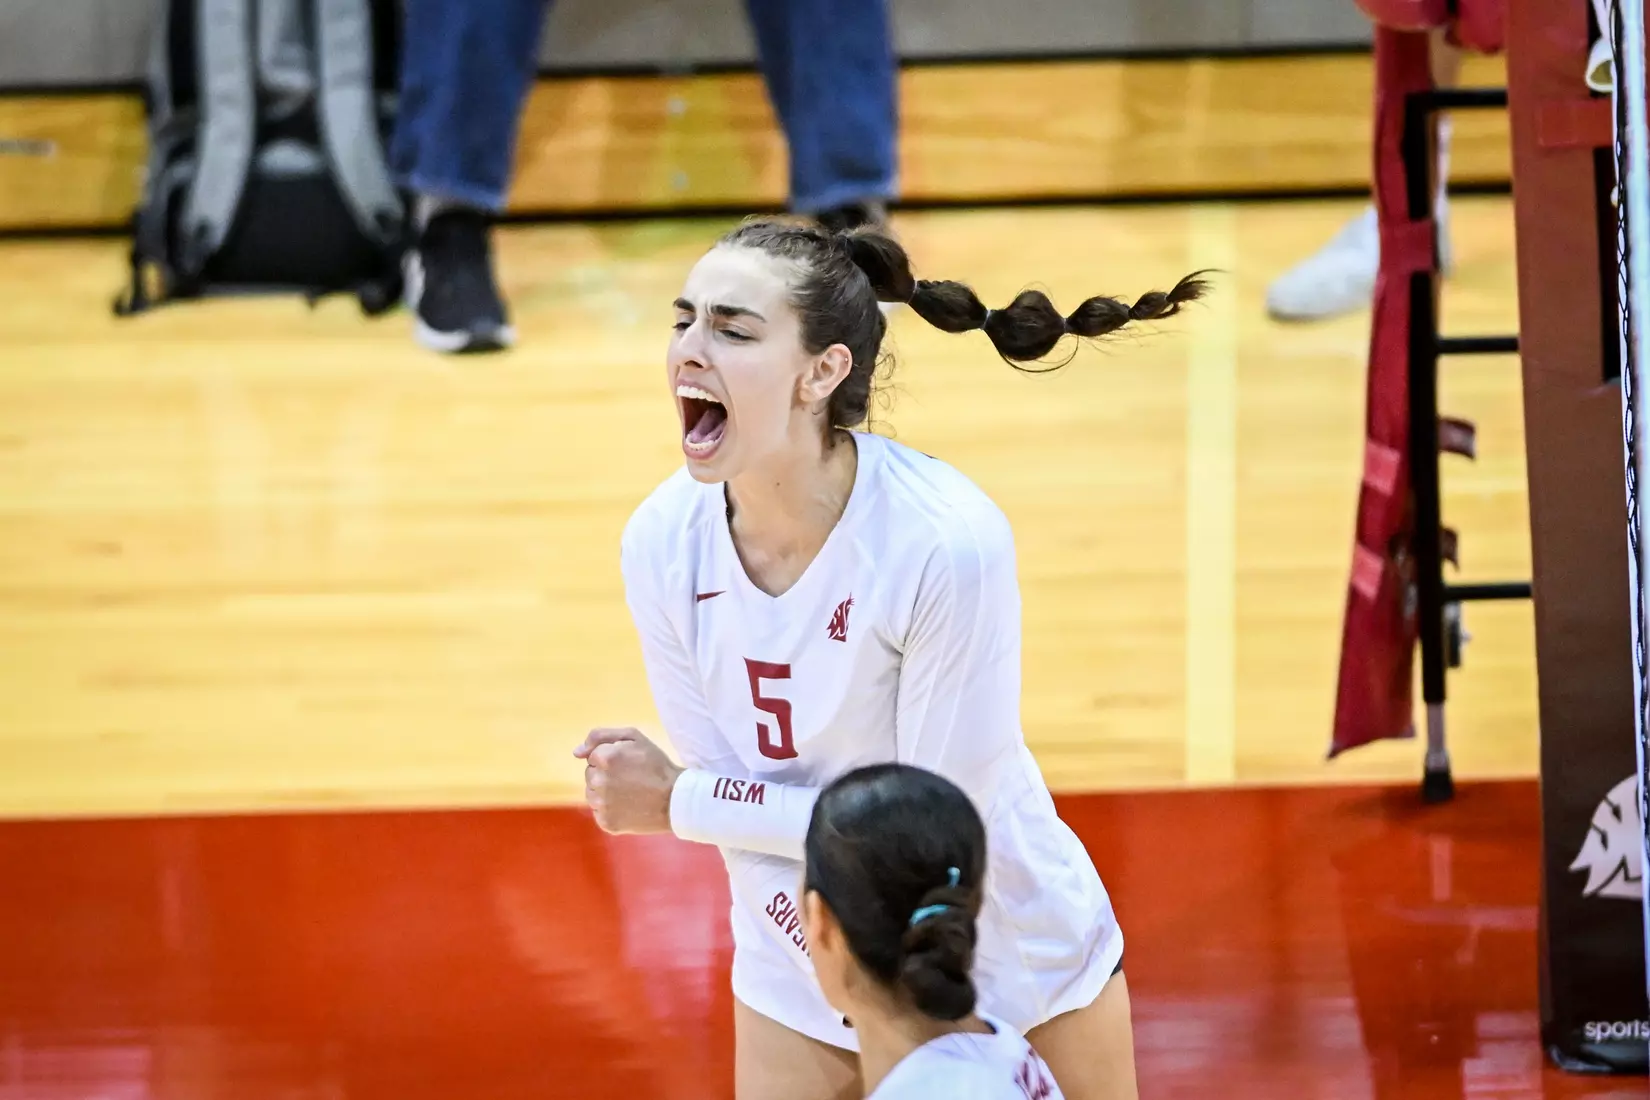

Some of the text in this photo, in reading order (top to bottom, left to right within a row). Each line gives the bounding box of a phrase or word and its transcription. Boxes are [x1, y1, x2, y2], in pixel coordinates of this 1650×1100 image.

[742, 656, 799, 760] 5
[713, 777, 766, 805] WSU
[766, 891, 811, 957] GARS
